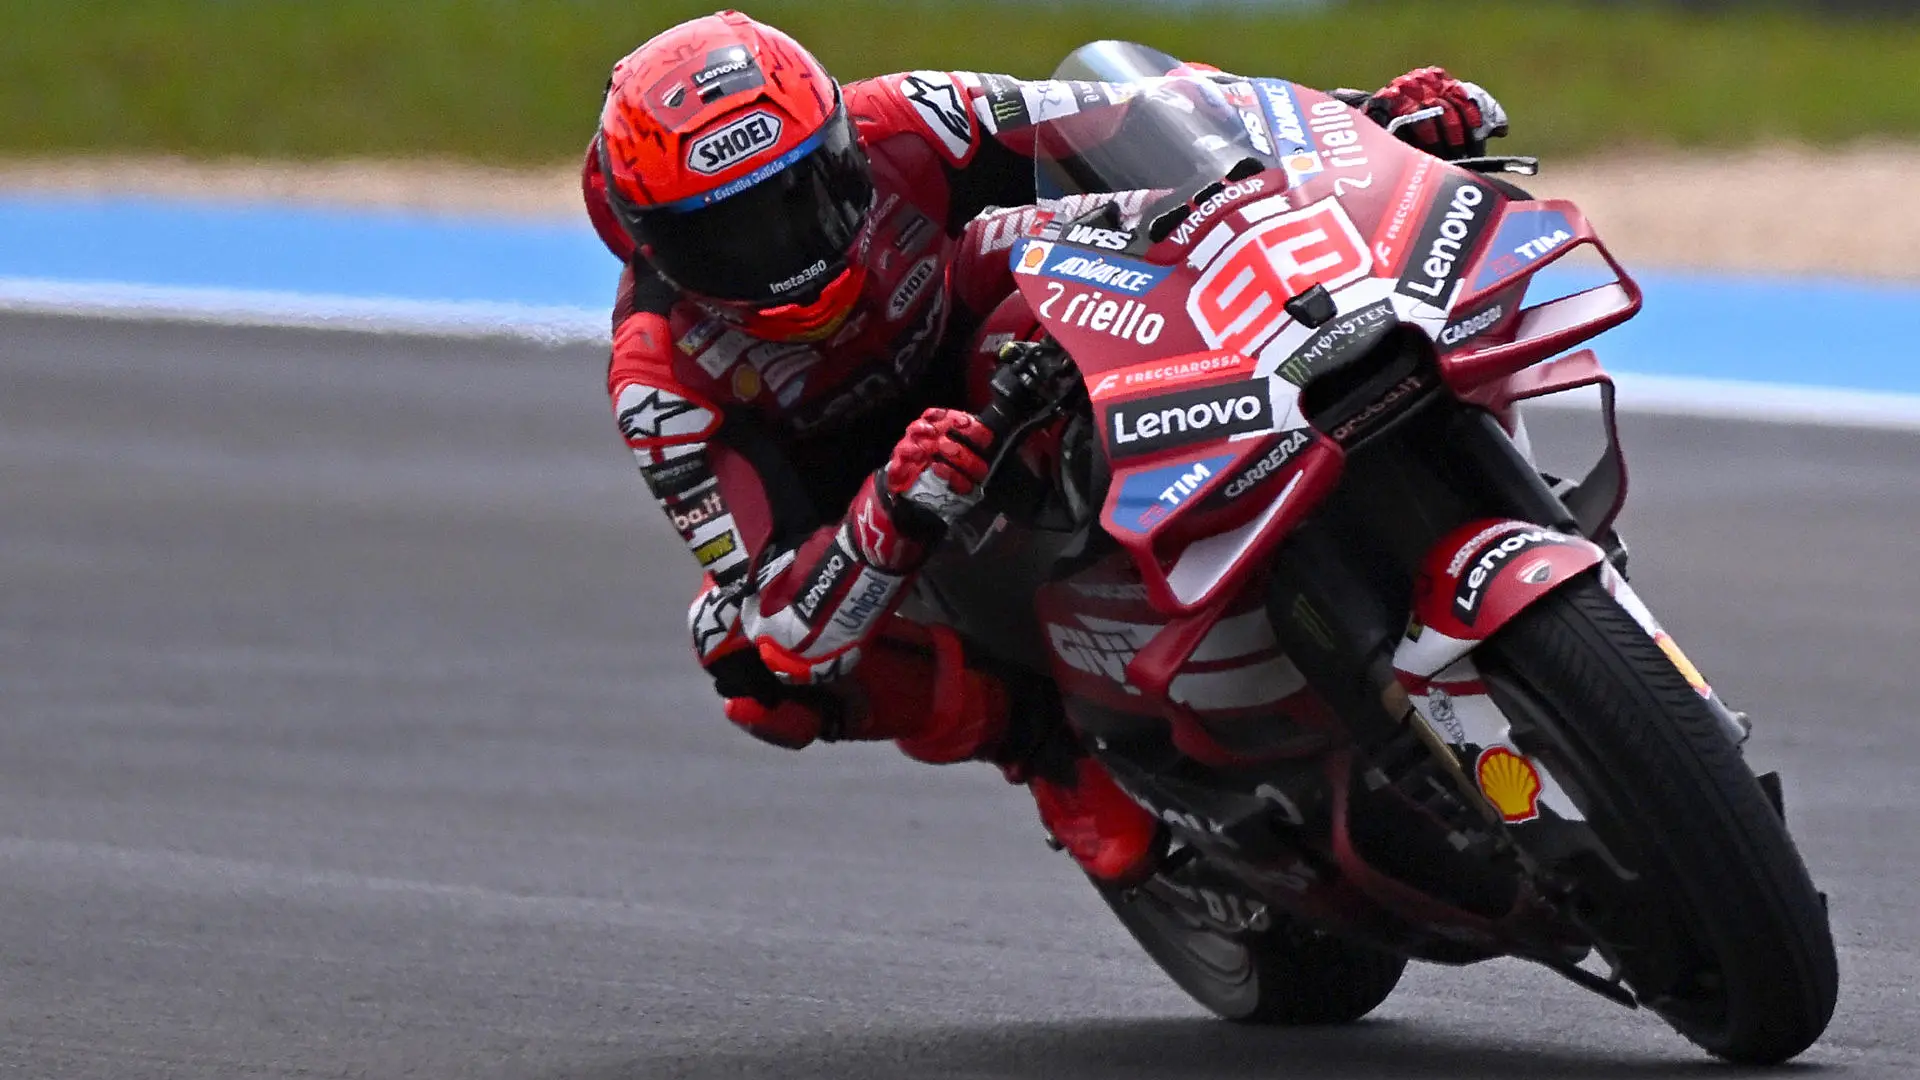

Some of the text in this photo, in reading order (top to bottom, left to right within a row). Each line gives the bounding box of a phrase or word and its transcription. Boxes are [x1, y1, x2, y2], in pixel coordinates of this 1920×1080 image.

[696, 60, 748, 84] Lenovo
[698, 117, 772, 168] SHOEI
[1308, 99, 1369, 168] riello
[714, 159, 785, 201] Estrella Galicia
[1066, 224, 1132, 250] WRS
[1169, 178, 1265, 246] VARGROUP
[1407, 184, 1484, 297] Lenovo
[1514, 229, 1571, 259] TIM
[769, 258, 828, 295] Insta360
[892, 262, 933, 313] SHOEI
[1050, 256, 1153, 292] ADVANCE
[1197, 207, 1362, 353] 93
[1061, 290, 1165, 345] riello
[1304, 303, 1395, 363] MONSTER
[1125, 354, 1241, 385] FRECCIAROSSA
[1114, 395, 1262, 444] Lenovo
[1159, 462, 1212, 505] TIM
[1224, 430, 1309, 498] CARRERA
[797, 554, 845, 619] Lenovo
[1456, 531, 1566, 612] Lenovo
[833, 571, 891, 629] Unipol
